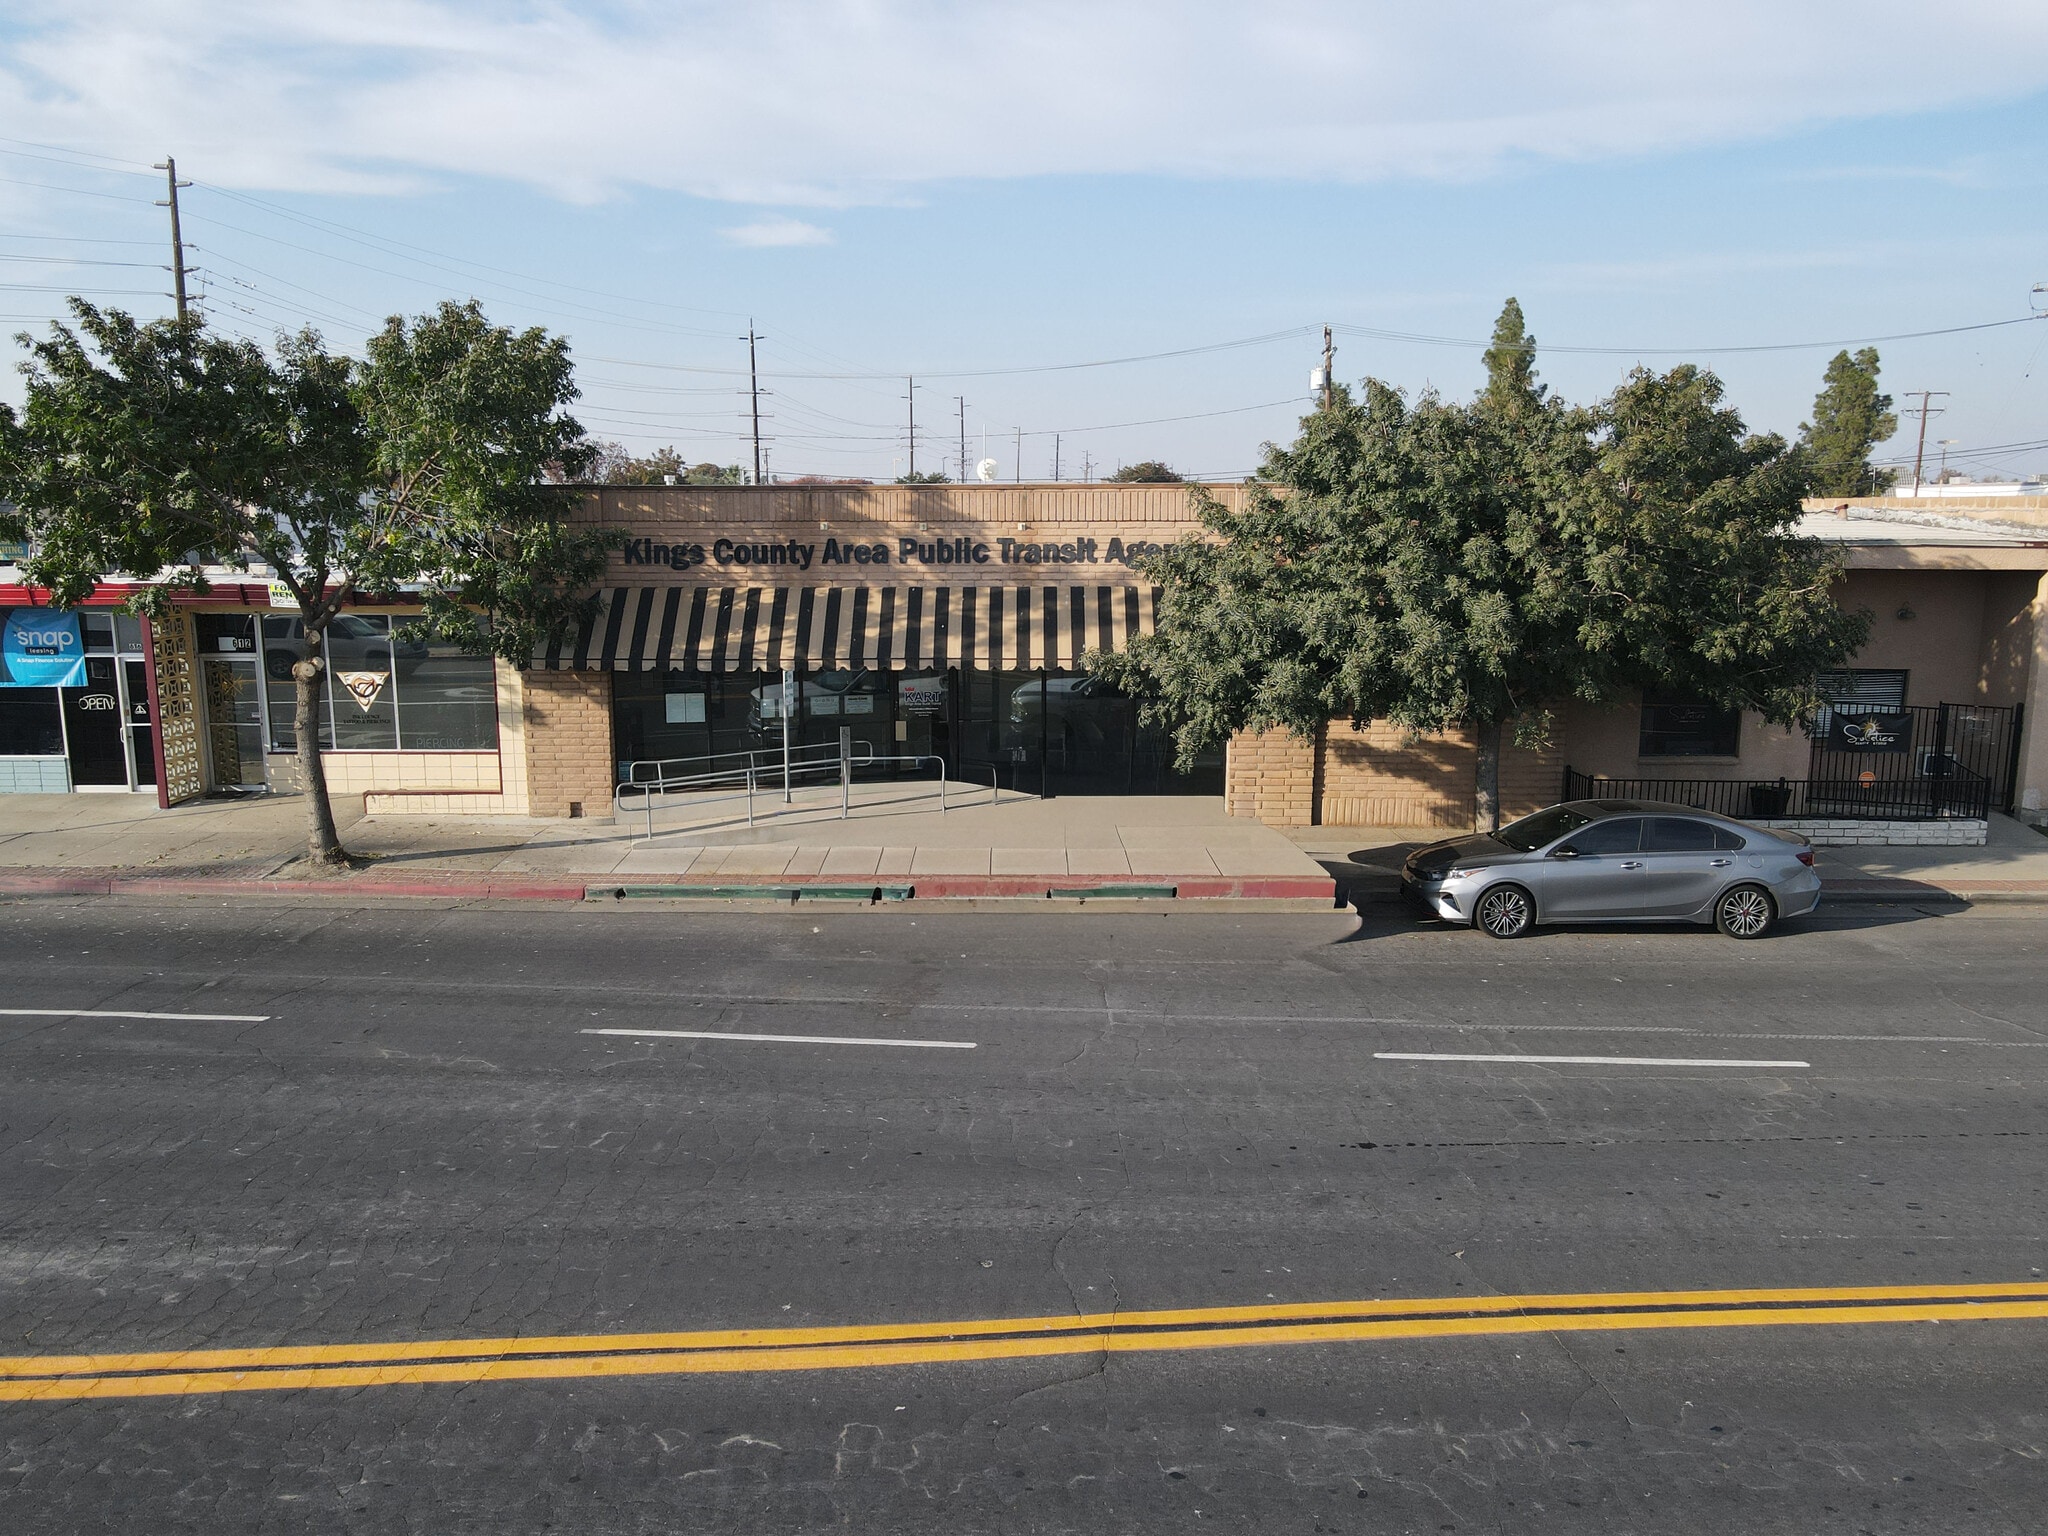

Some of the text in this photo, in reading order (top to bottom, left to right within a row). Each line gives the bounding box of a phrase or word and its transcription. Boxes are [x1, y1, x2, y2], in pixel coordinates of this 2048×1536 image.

[624, 538, 705, 570] Kings
[713, 538, 814, 570] County
[821, 538, 888, 564] Area
[899, 538, 990, 564] Public
[996, 537, 1097, 564] Transit
[17, 631, 74, 651] snap
[904, 691, 942, 702] KART
[79, 697, 115, 710] OPEN
[416, 738, 465, 749] PIERCING
